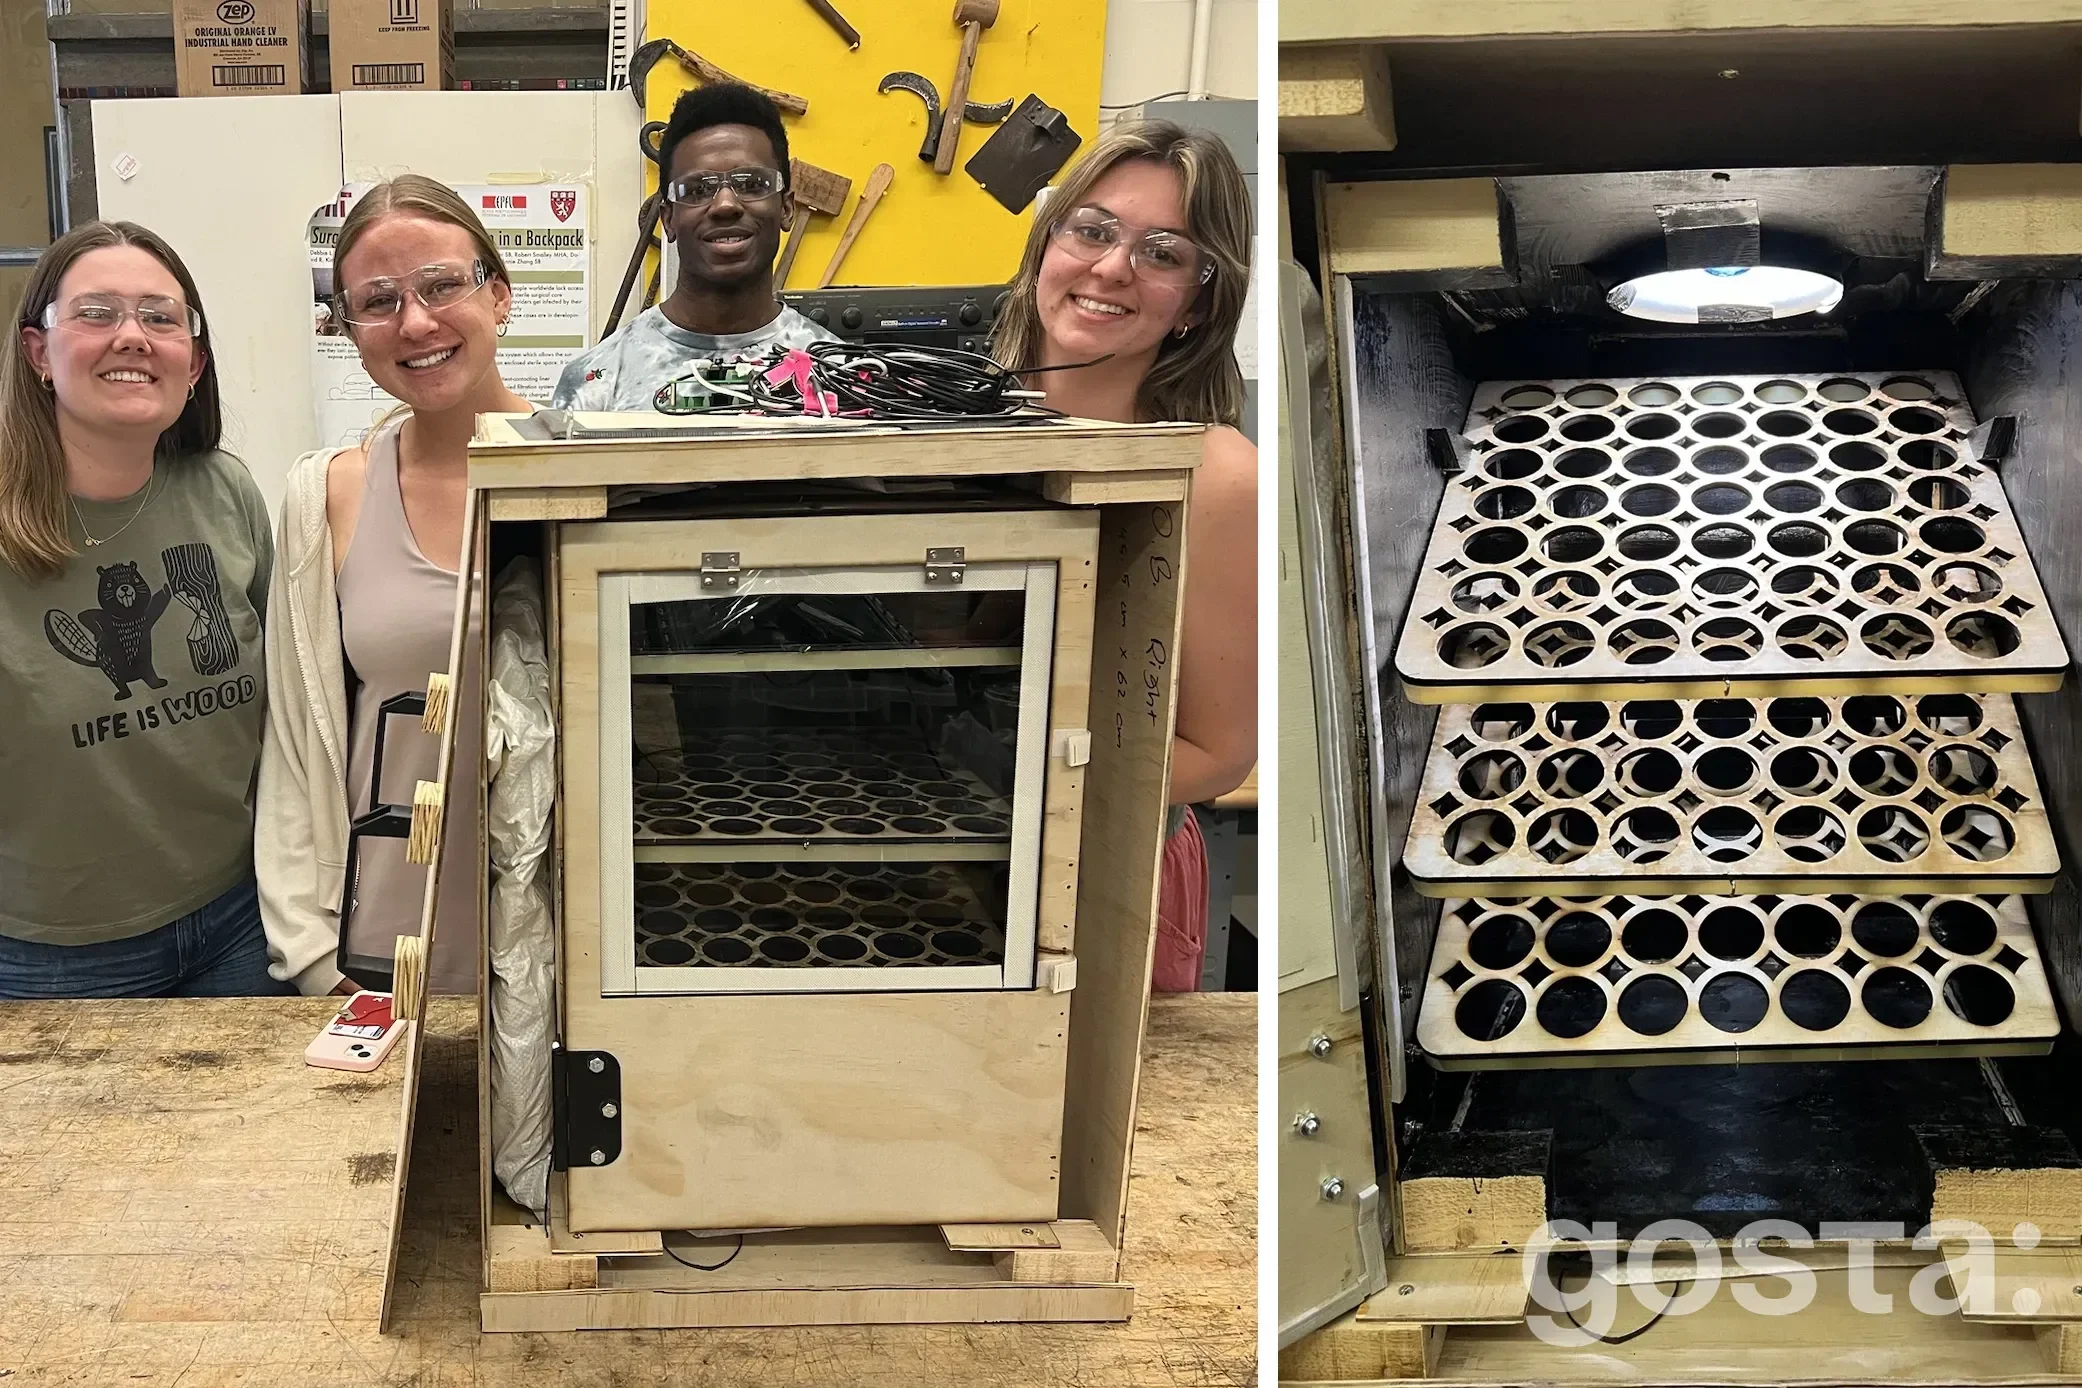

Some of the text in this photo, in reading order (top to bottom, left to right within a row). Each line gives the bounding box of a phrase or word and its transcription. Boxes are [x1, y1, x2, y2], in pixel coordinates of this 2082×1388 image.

[185, 37, 288, 47] INDUSTRIAL HAND CLEANER
[195, 27, 277, 36] ORIGINAL ORANGE LV
[312, 227, 583, 250] Surg in a Backpack
[1120, 601, 1128, 628] cm
[1117, 670, 1128, 699] 62
[1143, 638, 1167, 728] Right
[72, 674, 257, 749] LIFE IS WOOD
[1116, 712, 1124, 749] cm
